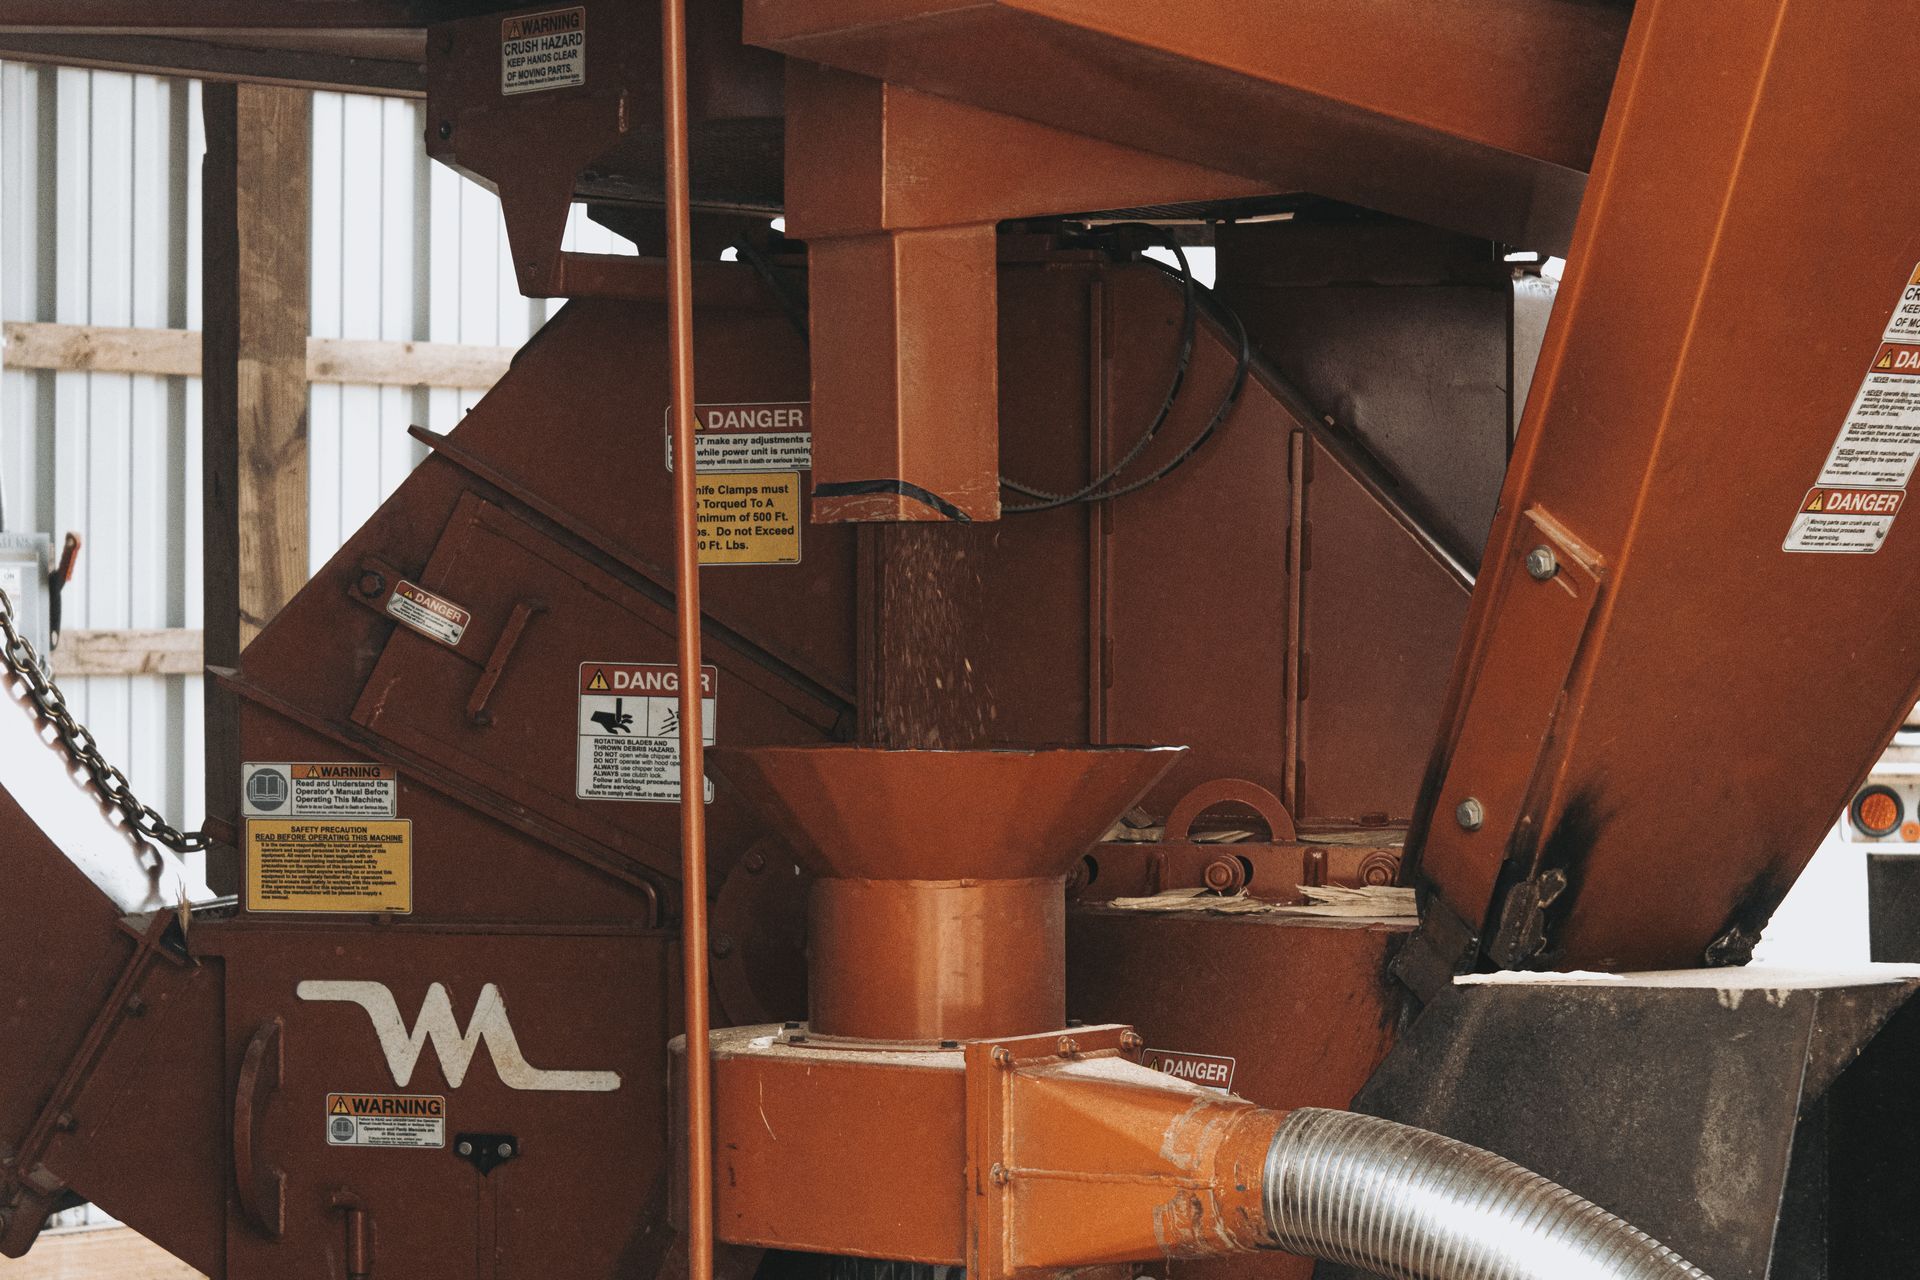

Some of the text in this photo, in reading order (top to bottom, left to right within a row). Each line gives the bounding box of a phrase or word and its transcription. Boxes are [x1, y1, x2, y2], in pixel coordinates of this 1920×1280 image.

[522, 12, 579, 35] WARNING
[504, 33, 582, 56] CRUSH HAZARD
[507, 49, 577, 68] KEEP HANDS CLEAR
[507, 71, 516, 81] OF
[518, 67, 546, 80] MOVING
[547, 63, 573, 75] PARTS.
[1895, 318, 1908, 327] OF
[708, 409, 803, 429] DANGER
[707, 437, 730, 445] make
[733, 438, 748, 446] any
[751, 436, 804, 446] adjustments
[697, 448, 719, 456] while
[722, 449, 749, 457] power
[752, 447, 768, 455] unit
[696, 485, 788, 496] nife Clamps must
[703, 498, 774, 510] Torqued To A
[1826, 493, 1899, 512] DANGER
[696, 512, 788, 522] inimum of 500 Ft.
[716, 526, 794, 536] Do not Exceed
[709, 541, 722, 550] Ft.
[726, 540, 749, 550] Lbs.
[414, 593, 461, 622] DANGER
[614, 671, 710, 692] DANGR
[321, 767, 380, 777] WARNING
[296, 788, 334, 796] Operator's
[364, 788, 388, 796] Before
[296, 796, 332, 804] Operating
[320, 826, 368, 834] PRECAUTION
[370, 834, 403, 842] MACHINE
[1163, 1059, 1228, 1082] DANGER
[352, 1098, 441, 1115] WARNING
